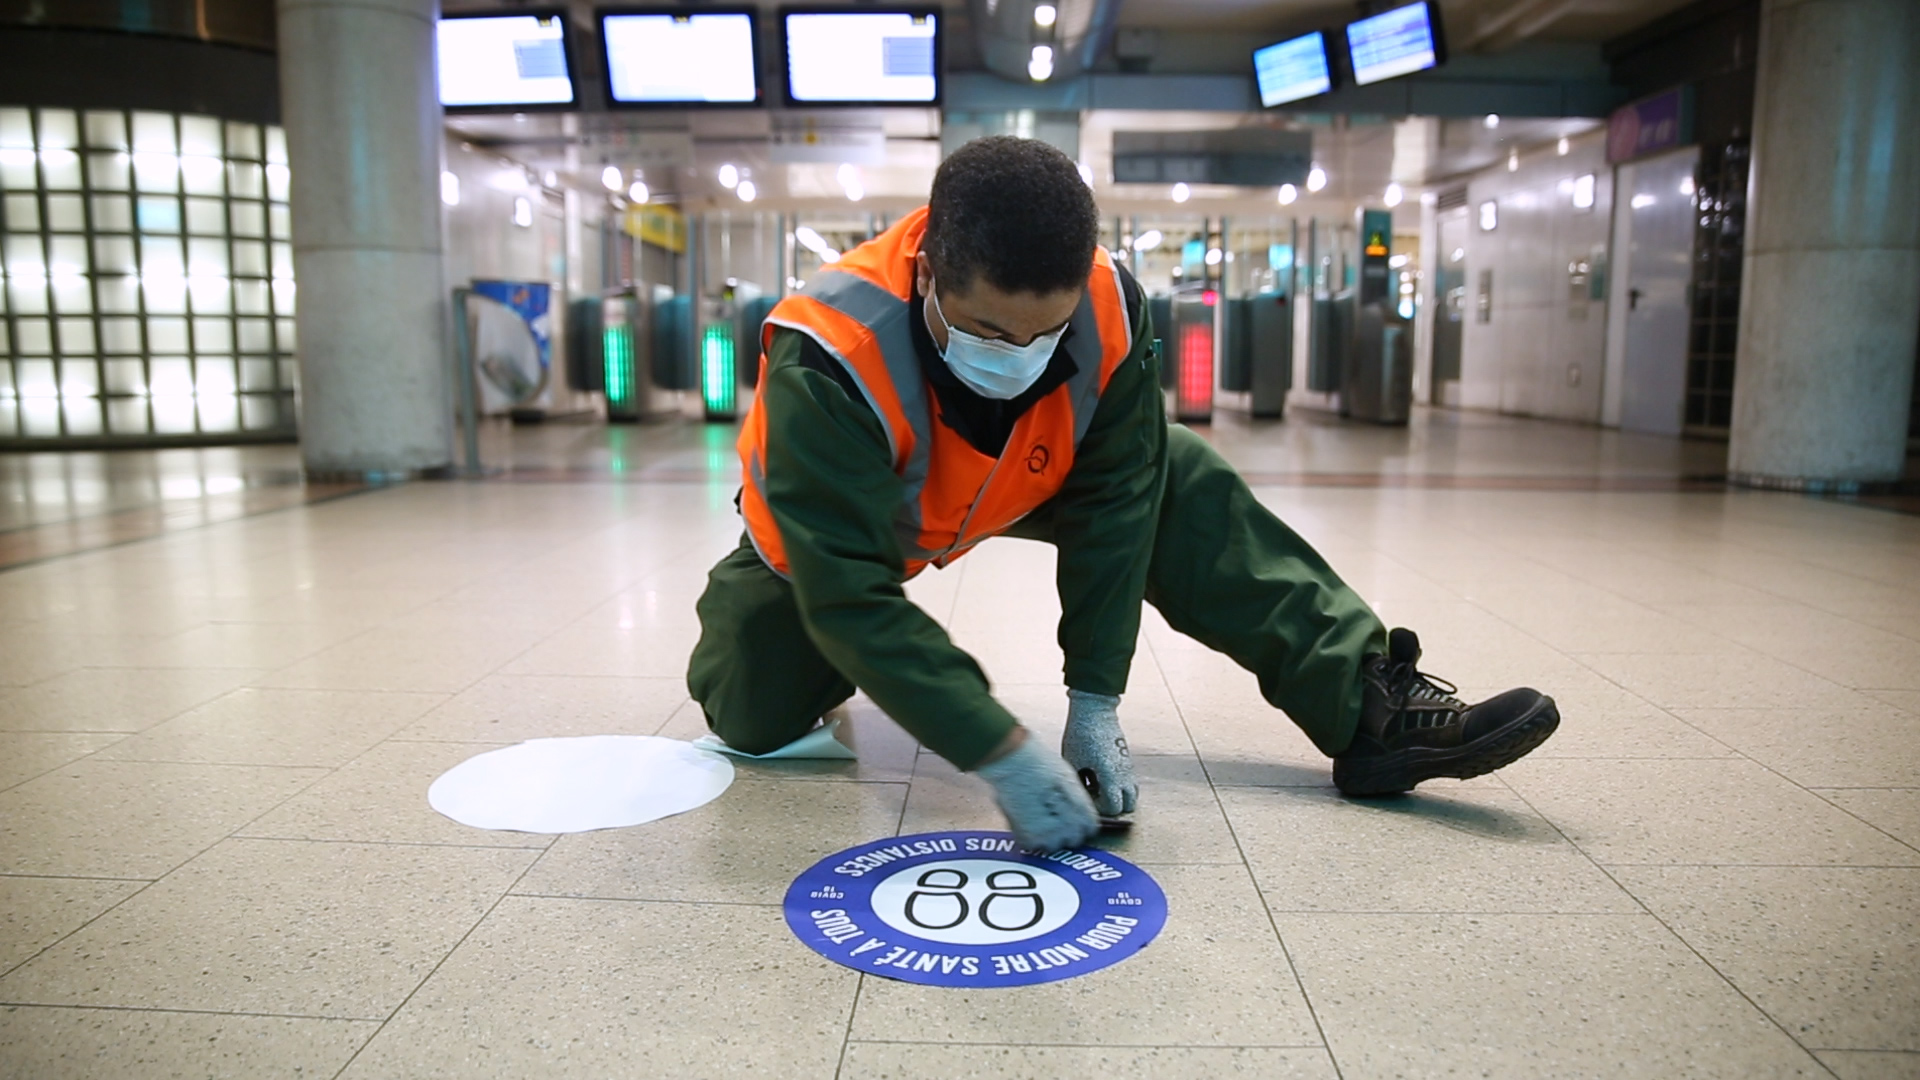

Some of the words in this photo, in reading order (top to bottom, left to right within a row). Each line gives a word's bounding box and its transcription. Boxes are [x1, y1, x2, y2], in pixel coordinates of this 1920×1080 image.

[834, 839, 957, 877] DISTANCES
[965, 838, 1015, 852] NOS
[1020, 849, 1122, 881] GARDO
[810, 891, 844, 899] COVID
[810, 909, 865, 944] TOUS
[1075, 914, 1139, 950] POUR
[849, 937, 886, 957] À
[873, 946, 980, 976] SANTÉ
[991, 943, 1090, 975] NOTRE
